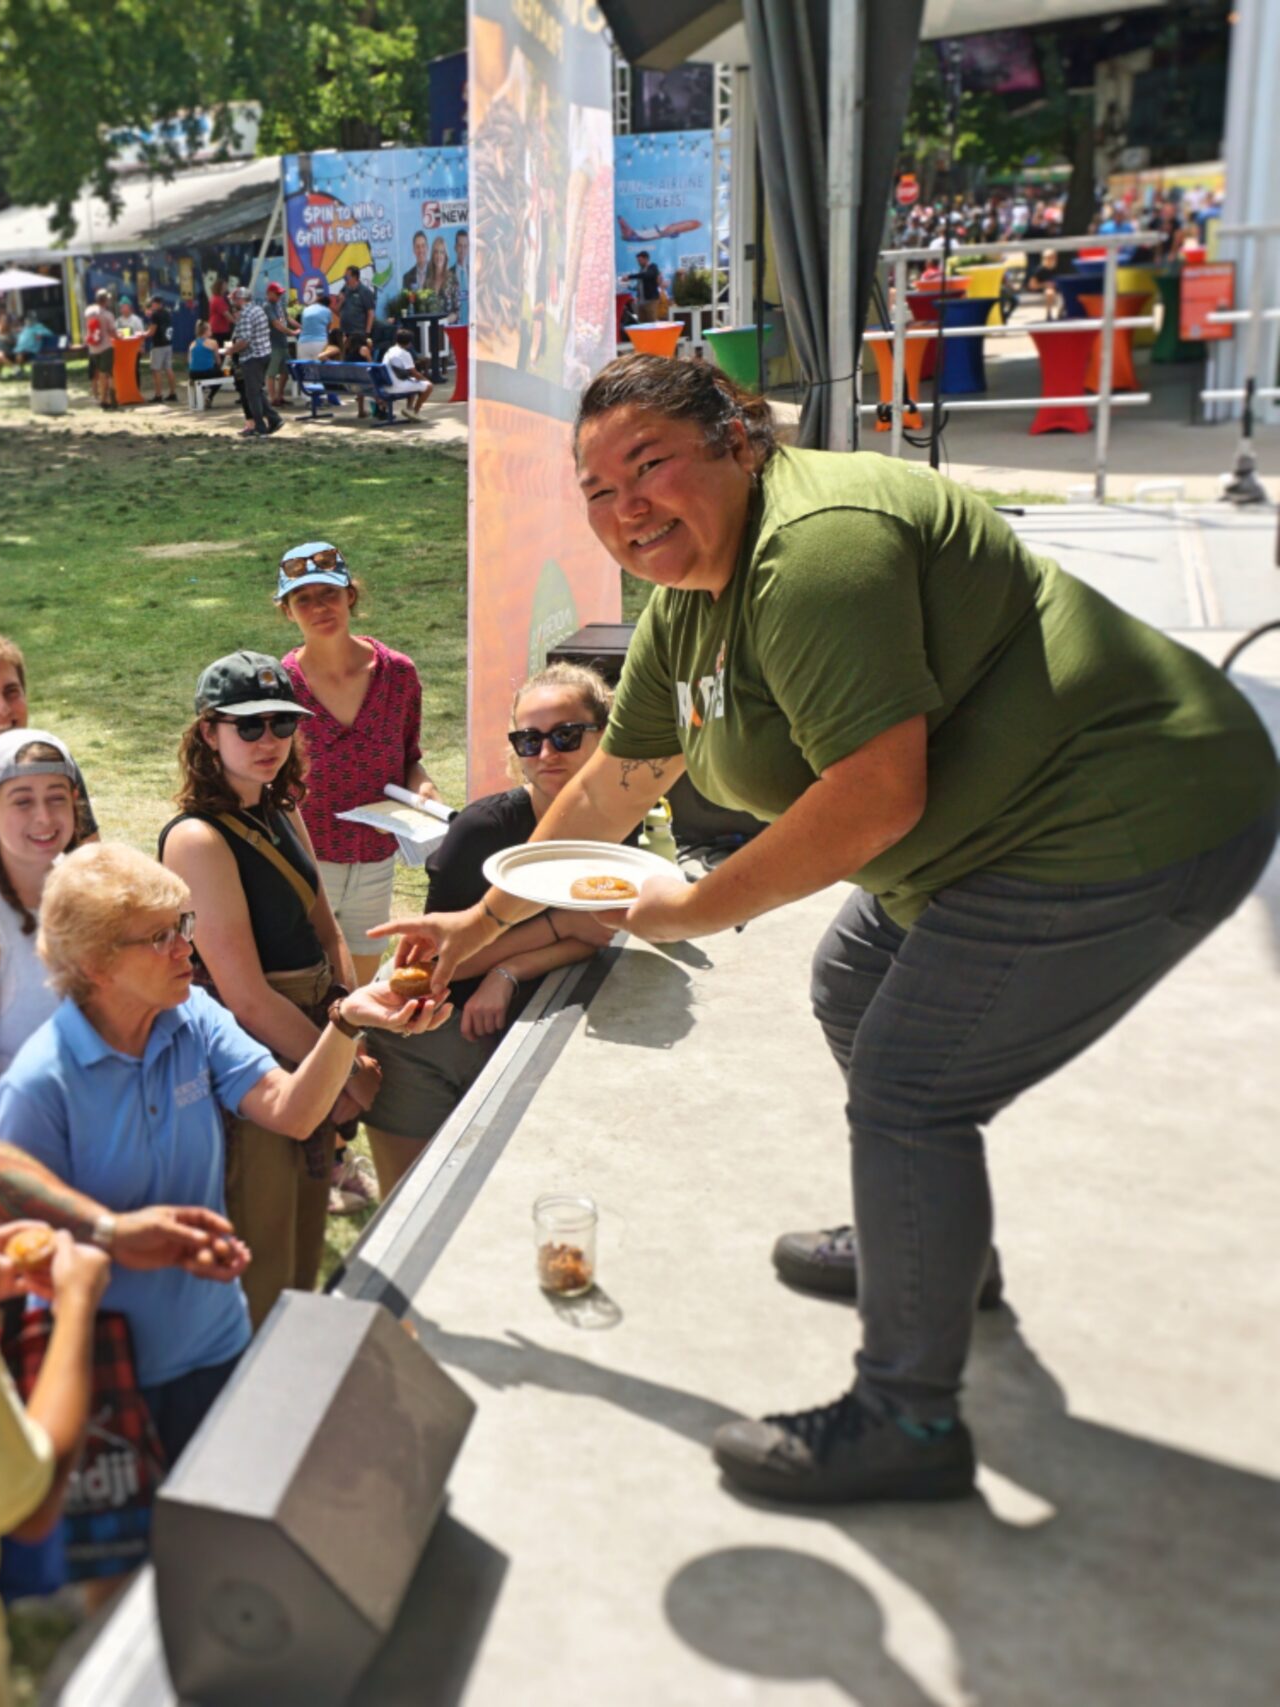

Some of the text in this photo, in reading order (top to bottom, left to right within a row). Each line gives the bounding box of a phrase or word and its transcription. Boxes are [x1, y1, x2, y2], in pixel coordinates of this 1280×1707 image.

[303, 205, 334, 224] SPIN
[352, 202, 375, 219] WIN
[296, 225, 325, 248] Grill
[336, 223, 369, 242] Patio
[371, 221, 393, 240] Set
